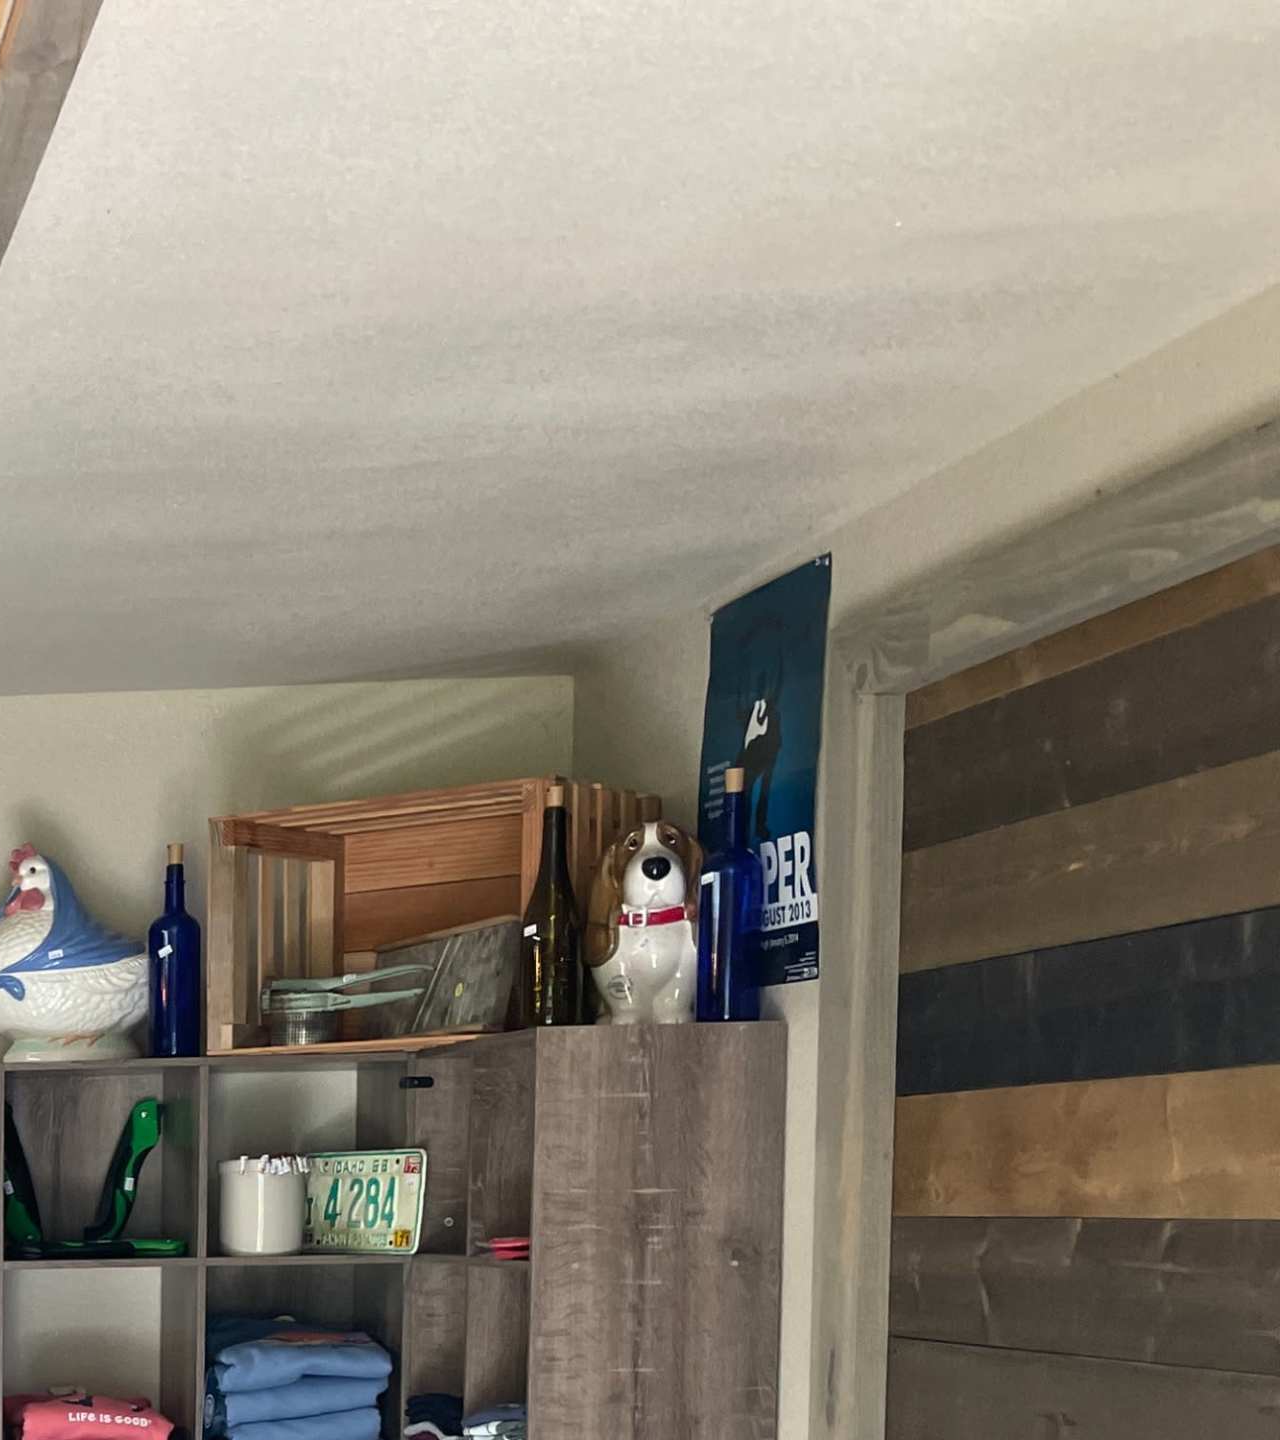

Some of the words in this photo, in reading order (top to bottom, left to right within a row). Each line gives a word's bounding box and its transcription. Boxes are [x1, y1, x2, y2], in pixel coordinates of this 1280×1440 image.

[760, 831, 813, 906] PER
[762, 906, 786, 927] GUST
[789, 901, 811, 921] 2013
[99, 1414, 112, 1424] IS
[115, 1415, 149, 1427] GOOD
